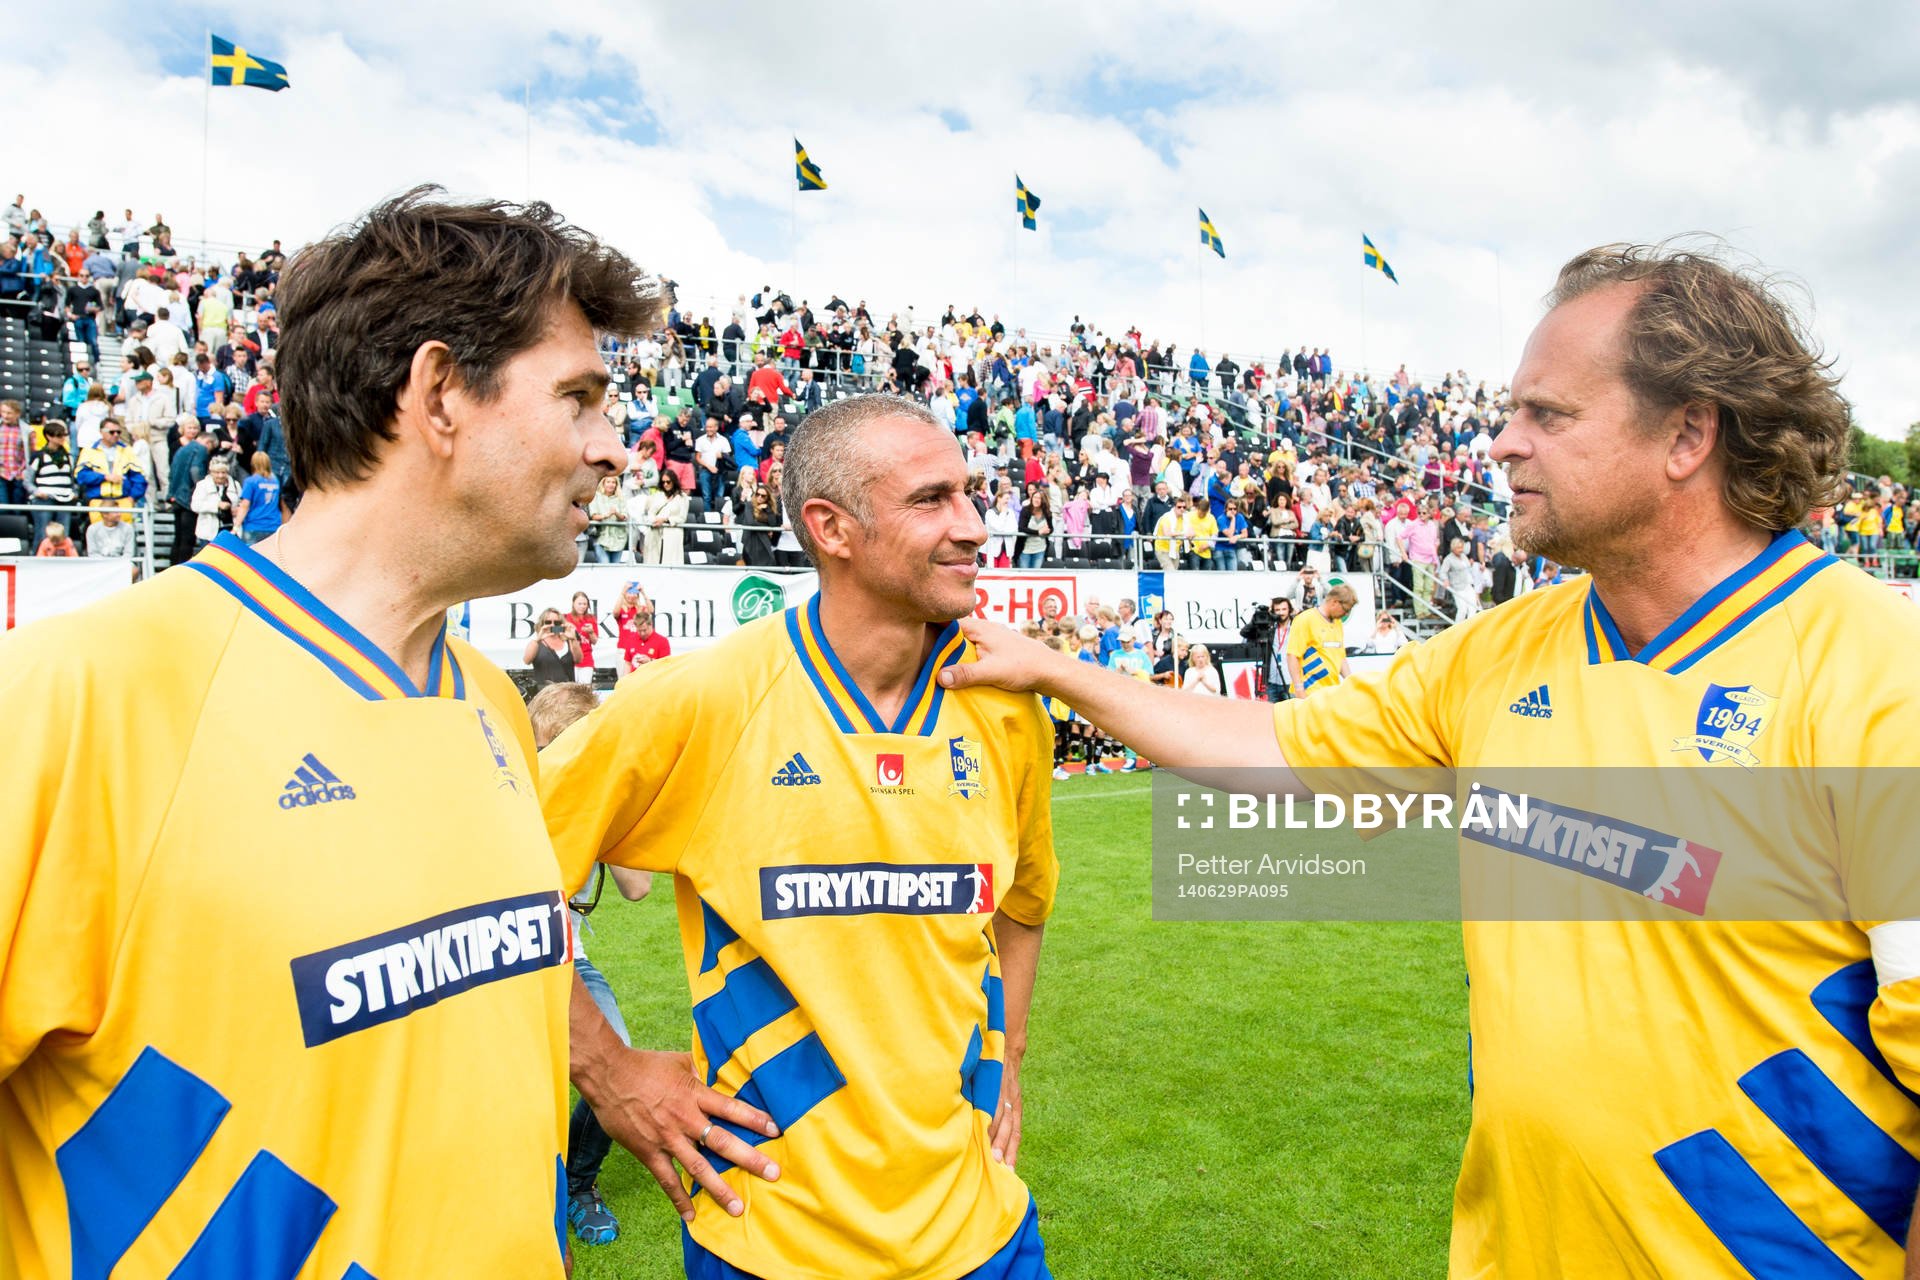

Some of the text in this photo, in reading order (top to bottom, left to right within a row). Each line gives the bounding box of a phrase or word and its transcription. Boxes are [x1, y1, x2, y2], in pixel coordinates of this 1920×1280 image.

[508, 599, 717, 639] Bkhill
[1509, 700, 1552, 718] adidas
[1703, 706, 1762, 736] 1994
[1695, 737, 1742, 755] SVERIGE
[771, 771, 822, 787] adidas
[952, 755, 979, 773] 1994
[278, 780, 356, 810] adidas
[775, 869, 958, 911] STRYKTIPSET
[324, 903, 551, 1025] STRYKTIPSET
